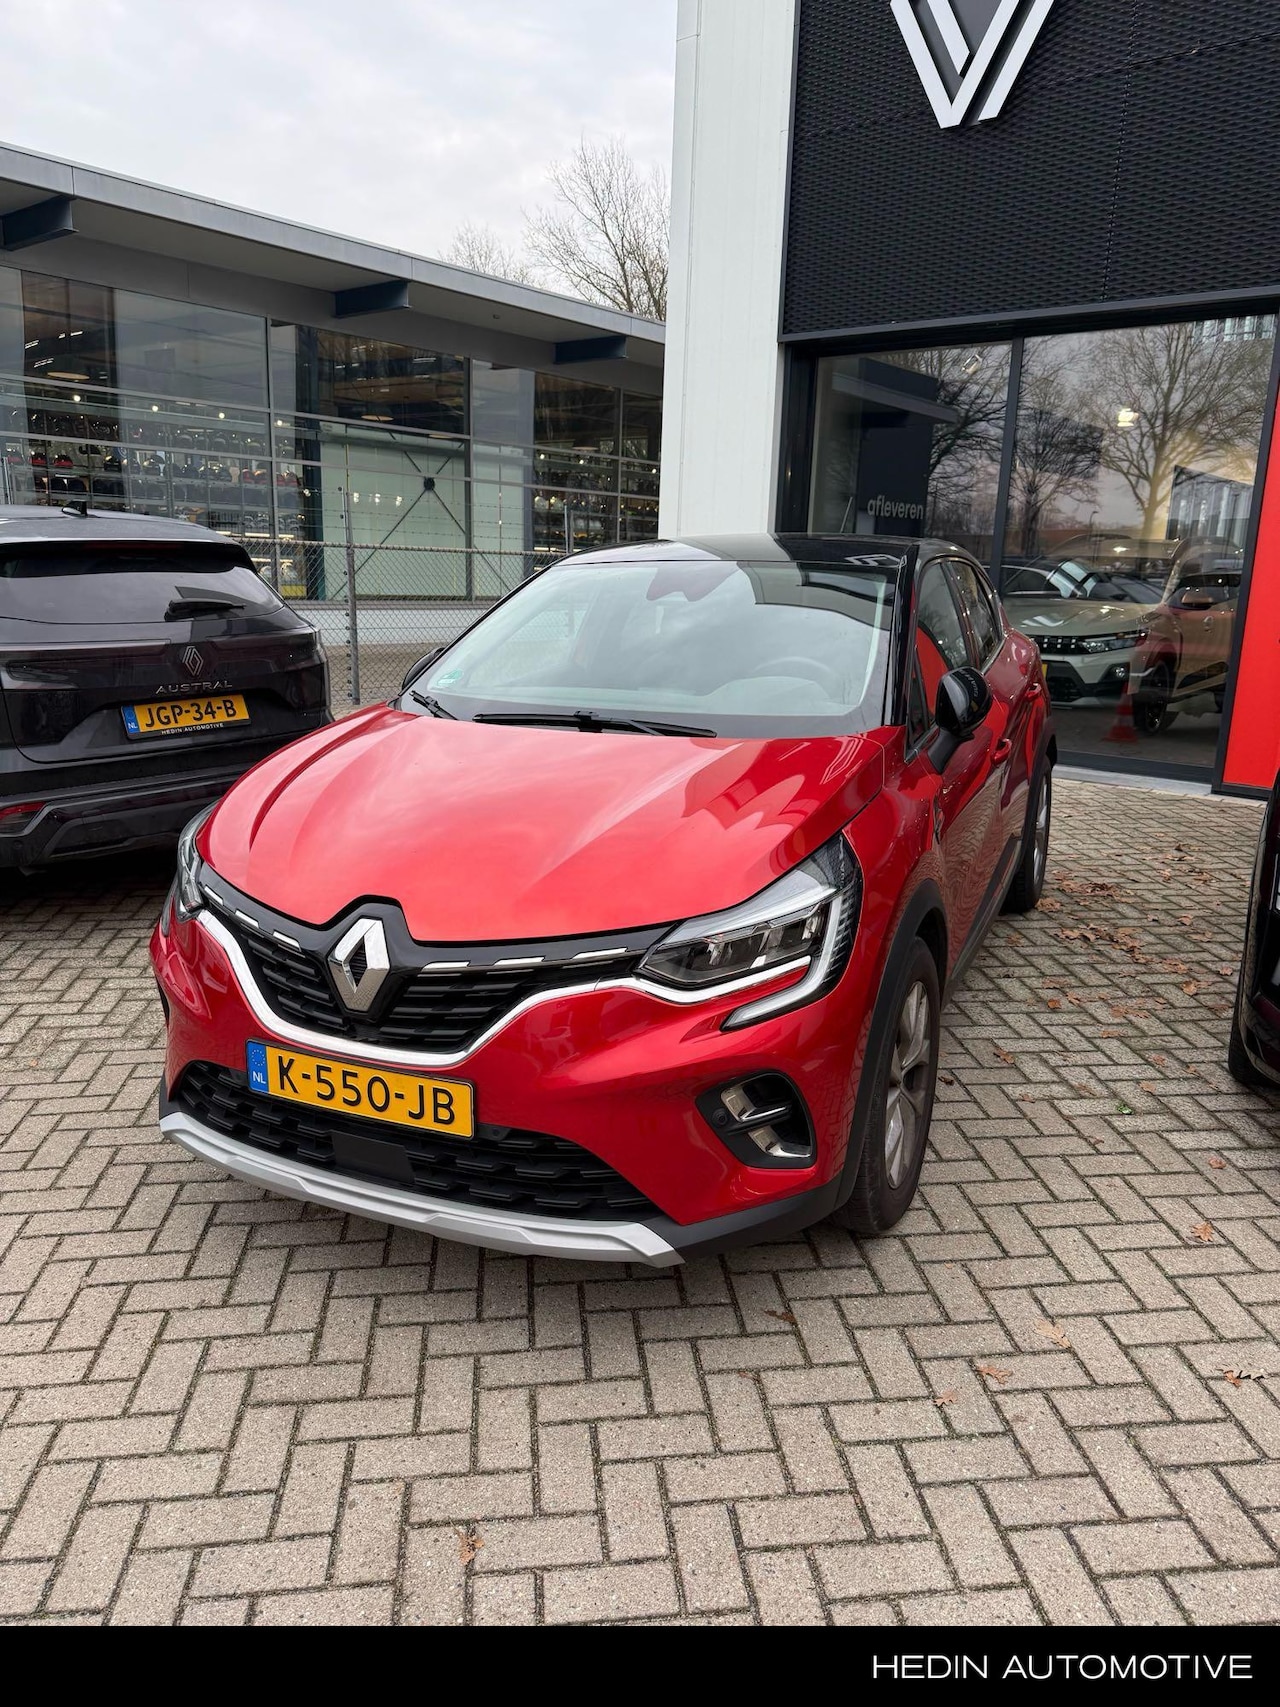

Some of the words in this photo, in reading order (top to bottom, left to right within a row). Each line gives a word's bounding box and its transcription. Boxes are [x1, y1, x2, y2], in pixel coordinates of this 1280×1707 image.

[867, 495, 924, 520] afleveren
[155, 680, 233, 694] AUSTRAL
[145, 699, 237, 728] JGP-34-B
[128, 722, 138, 730] NL
[184, 722, 224, 732] AUTOMOTIVE
[252, 1072, 266, 1084] NL
[278, 1055, 455, 1125] K-550-JB
